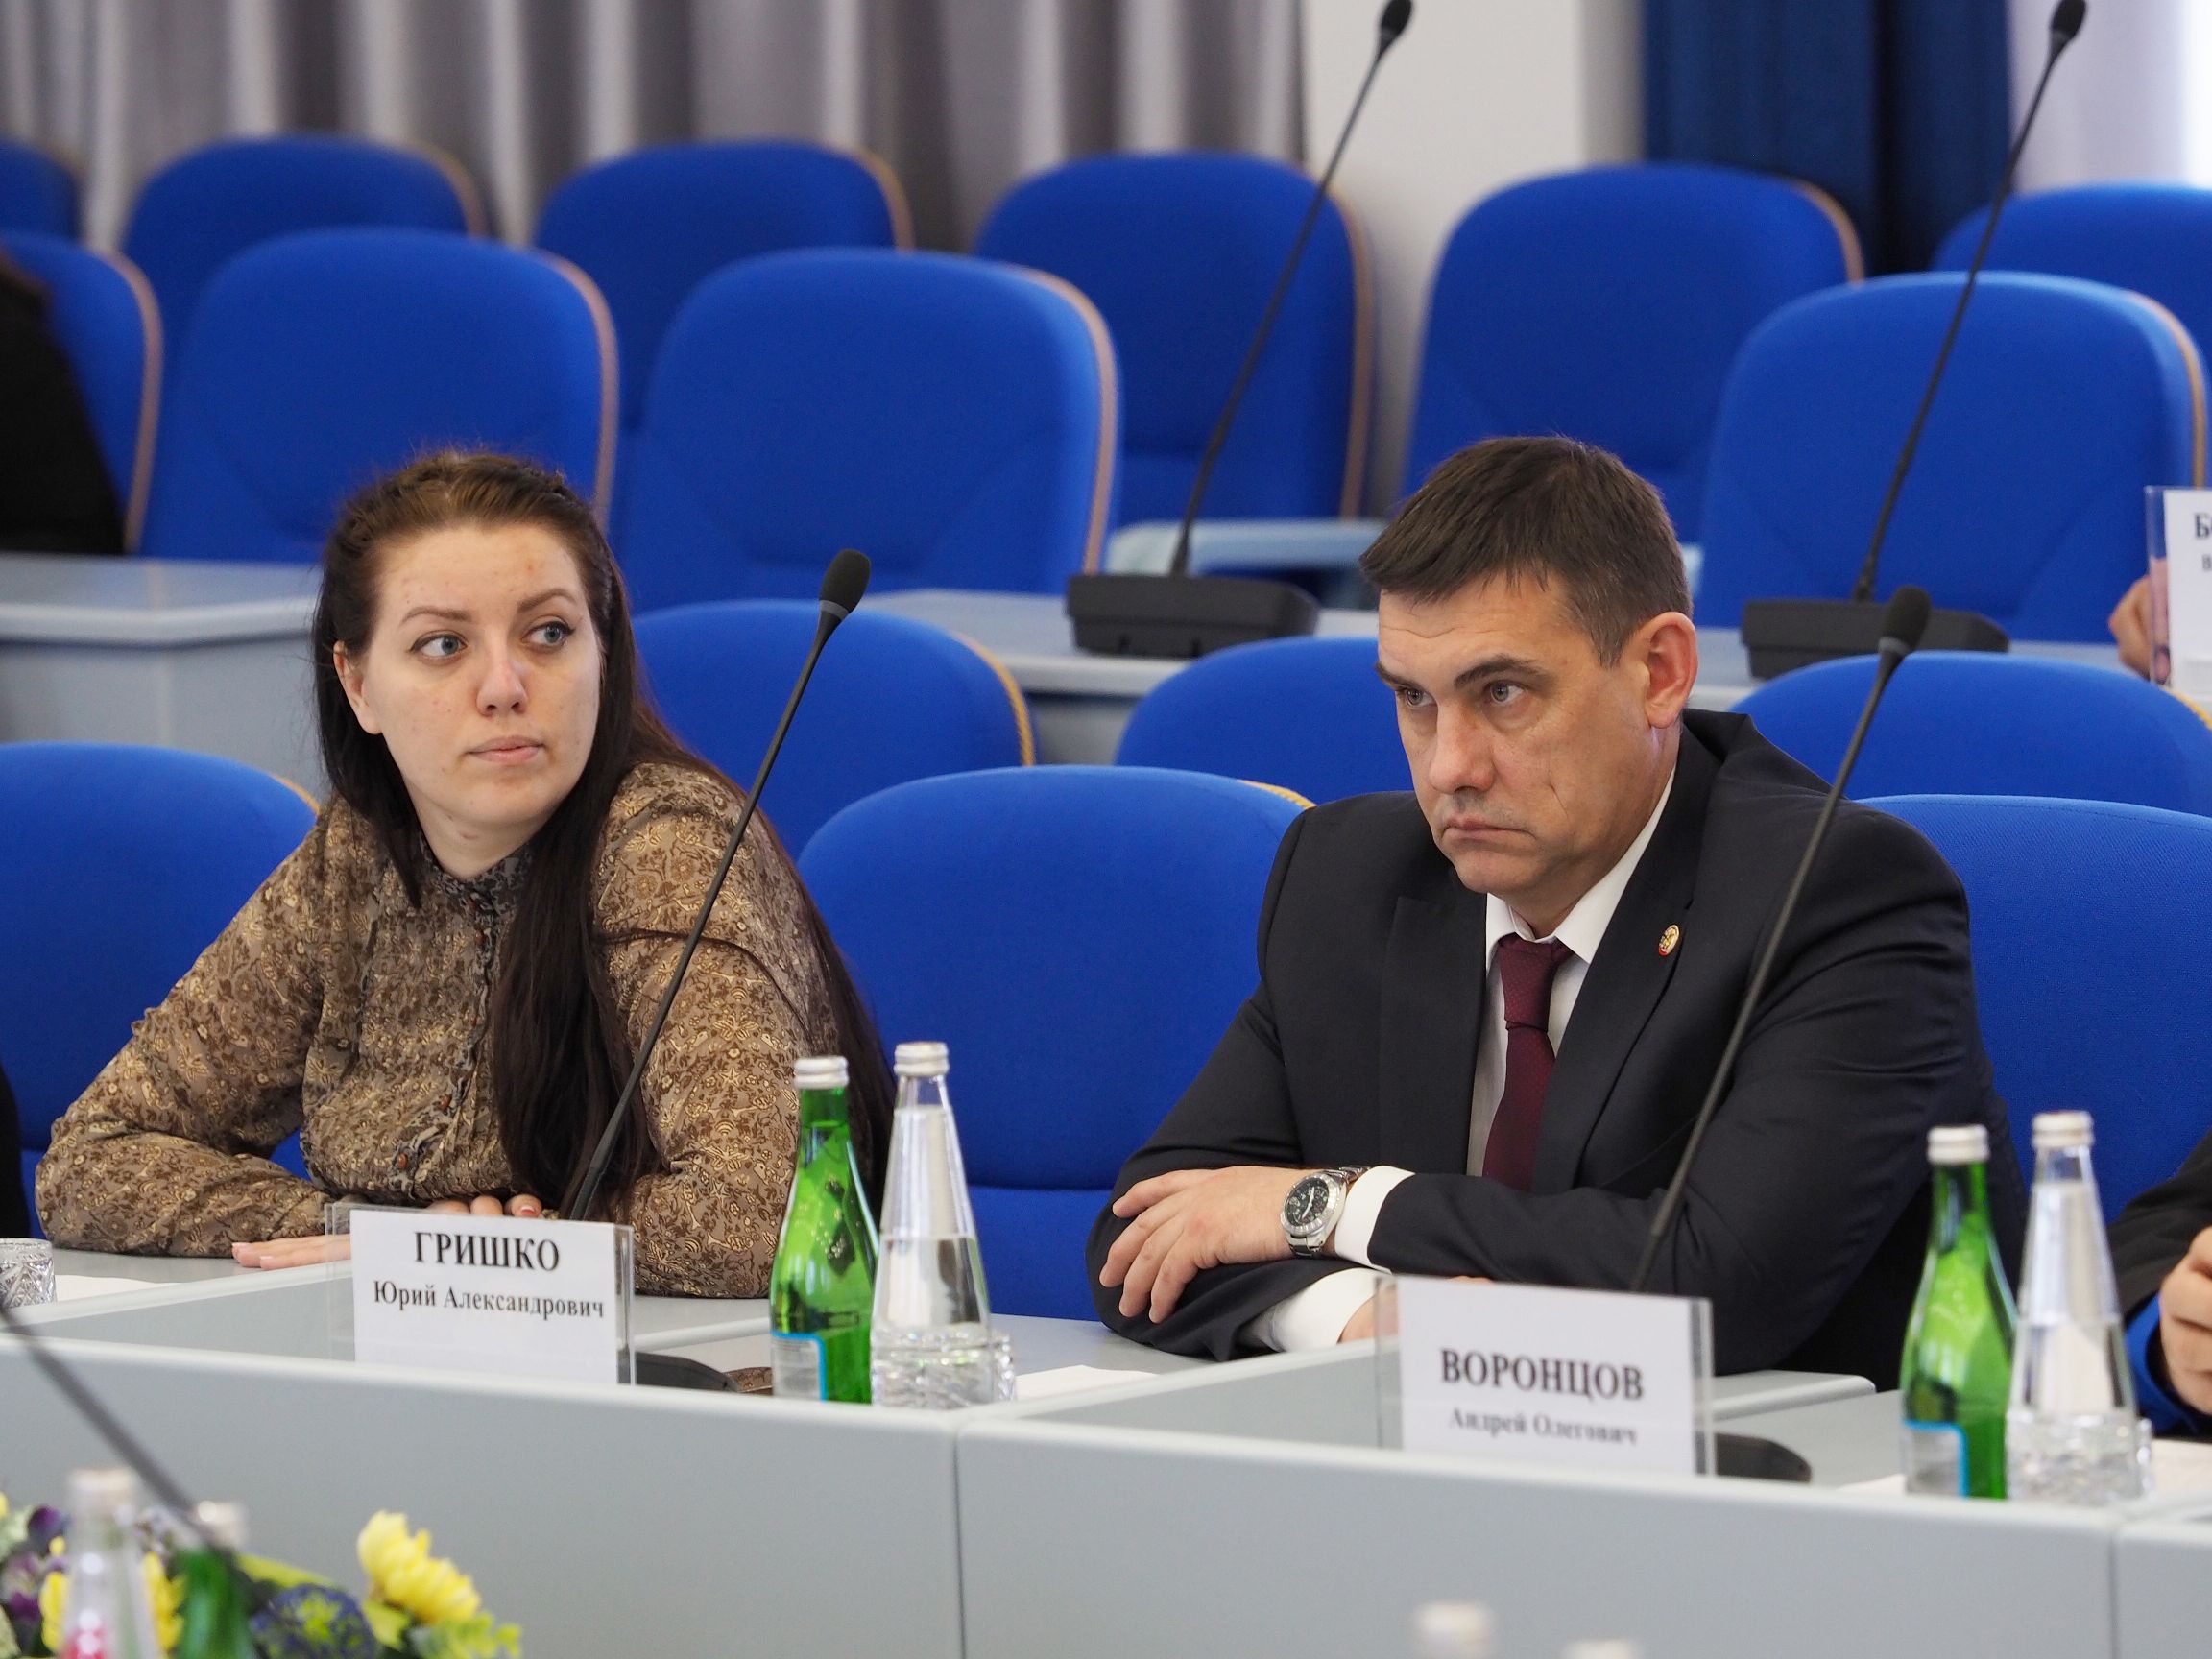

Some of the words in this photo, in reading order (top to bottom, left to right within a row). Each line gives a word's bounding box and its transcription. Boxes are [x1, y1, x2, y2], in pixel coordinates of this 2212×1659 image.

[415, 1231, 560, 1271] ГРИШКО
[373, 1280, 436, 1310] Юрий
[444, 1286, 604, 1320] Александрович
[1441, 1348, 1645, 1402] ВОРОНЦОВ
[1450, 1407, 1527, 1439] Андрей
[1533, 1413, 1637, 1445] Олегович
